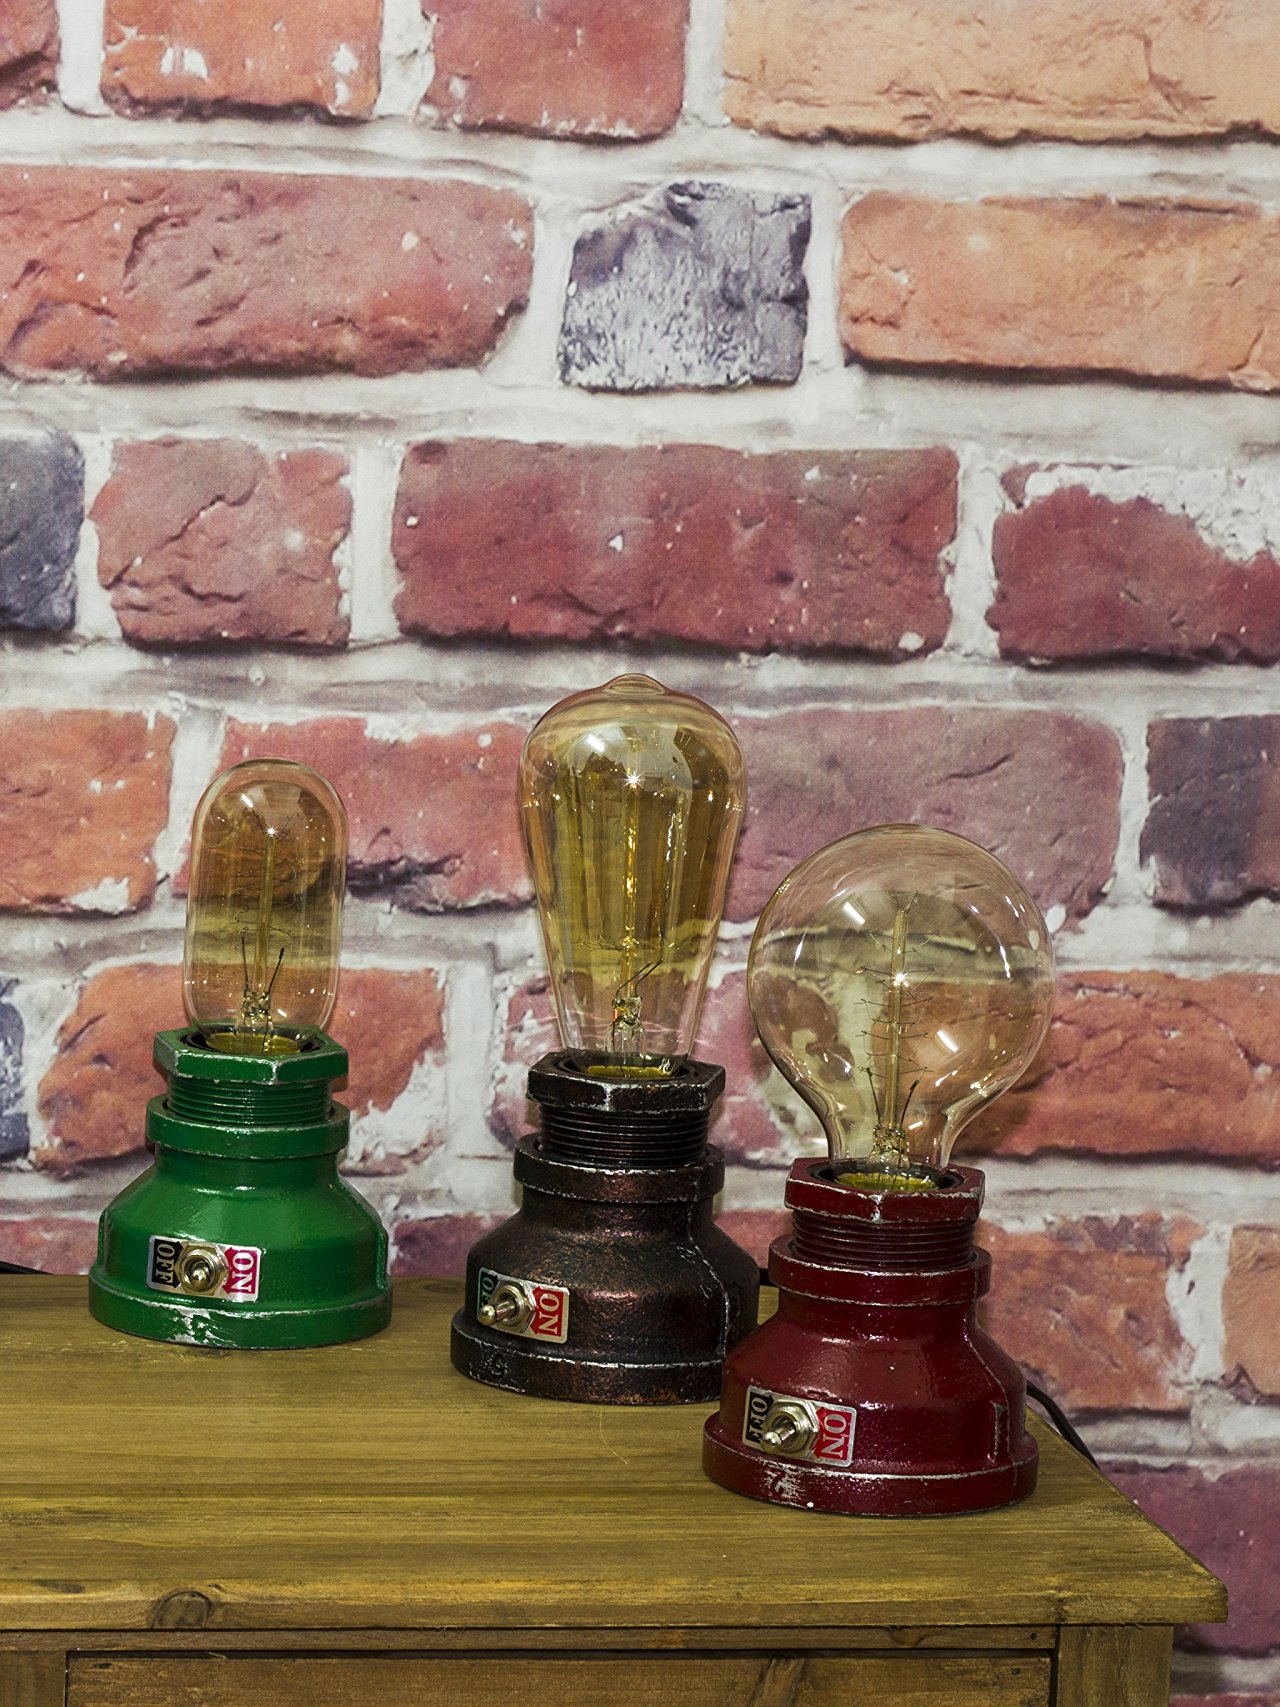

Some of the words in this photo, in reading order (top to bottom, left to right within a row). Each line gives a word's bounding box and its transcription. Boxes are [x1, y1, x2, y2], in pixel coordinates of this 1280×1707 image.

[155, 1242, 176, 1284] OFF
[230, 1251, 255, 1293] ON
[538, 1292, 560, 1336] ON
[821, 1413, 847, 1459] ON
